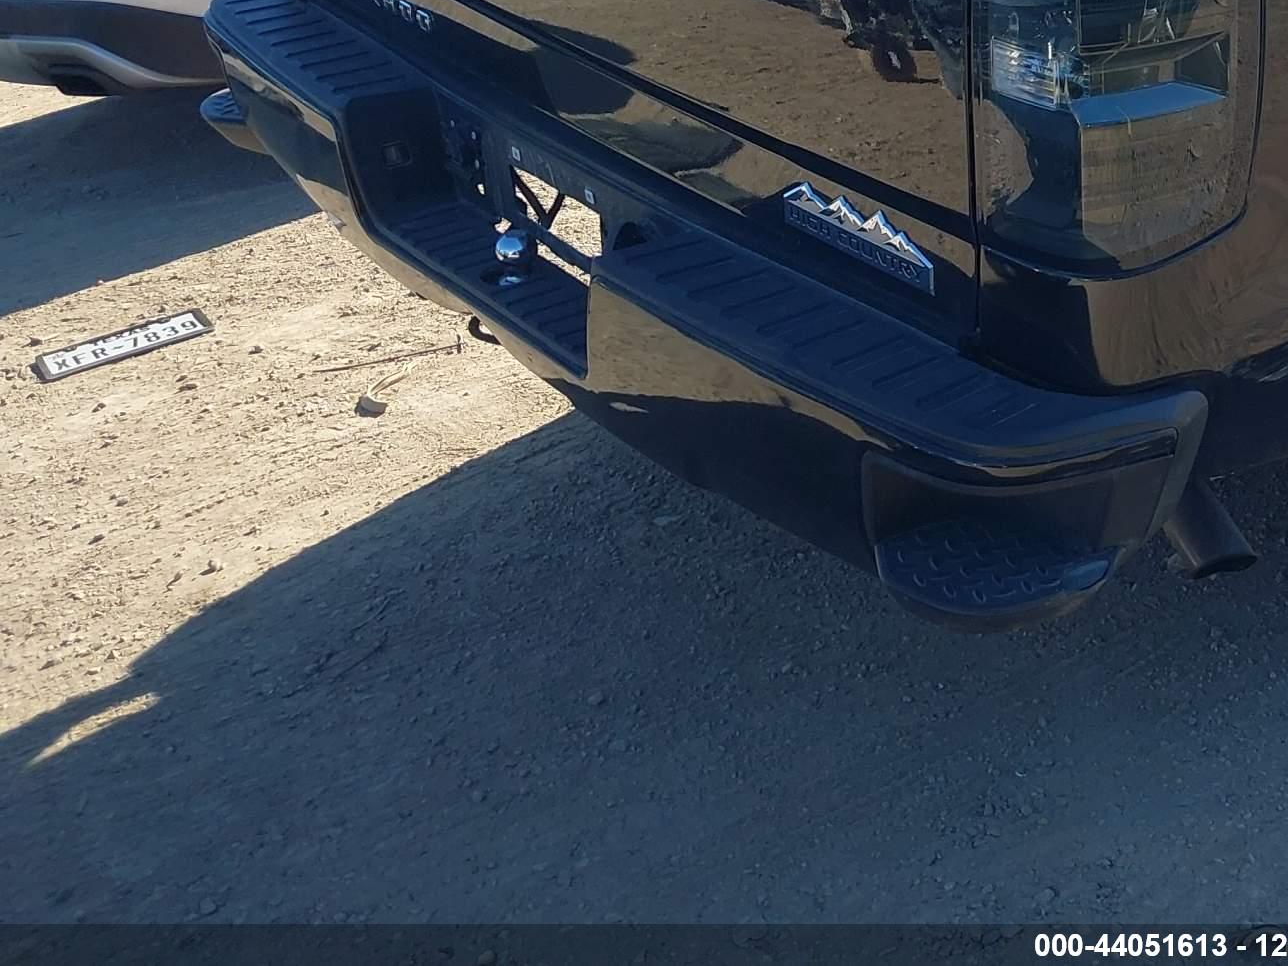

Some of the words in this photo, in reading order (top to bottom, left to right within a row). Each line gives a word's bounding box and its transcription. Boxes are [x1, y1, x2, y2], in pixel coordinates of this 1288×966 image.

[789, 208, 832, 240] HIGH
[838, 234, 920, 283] COUNTRY
[54, 320, 198, 371] XFR-7839
